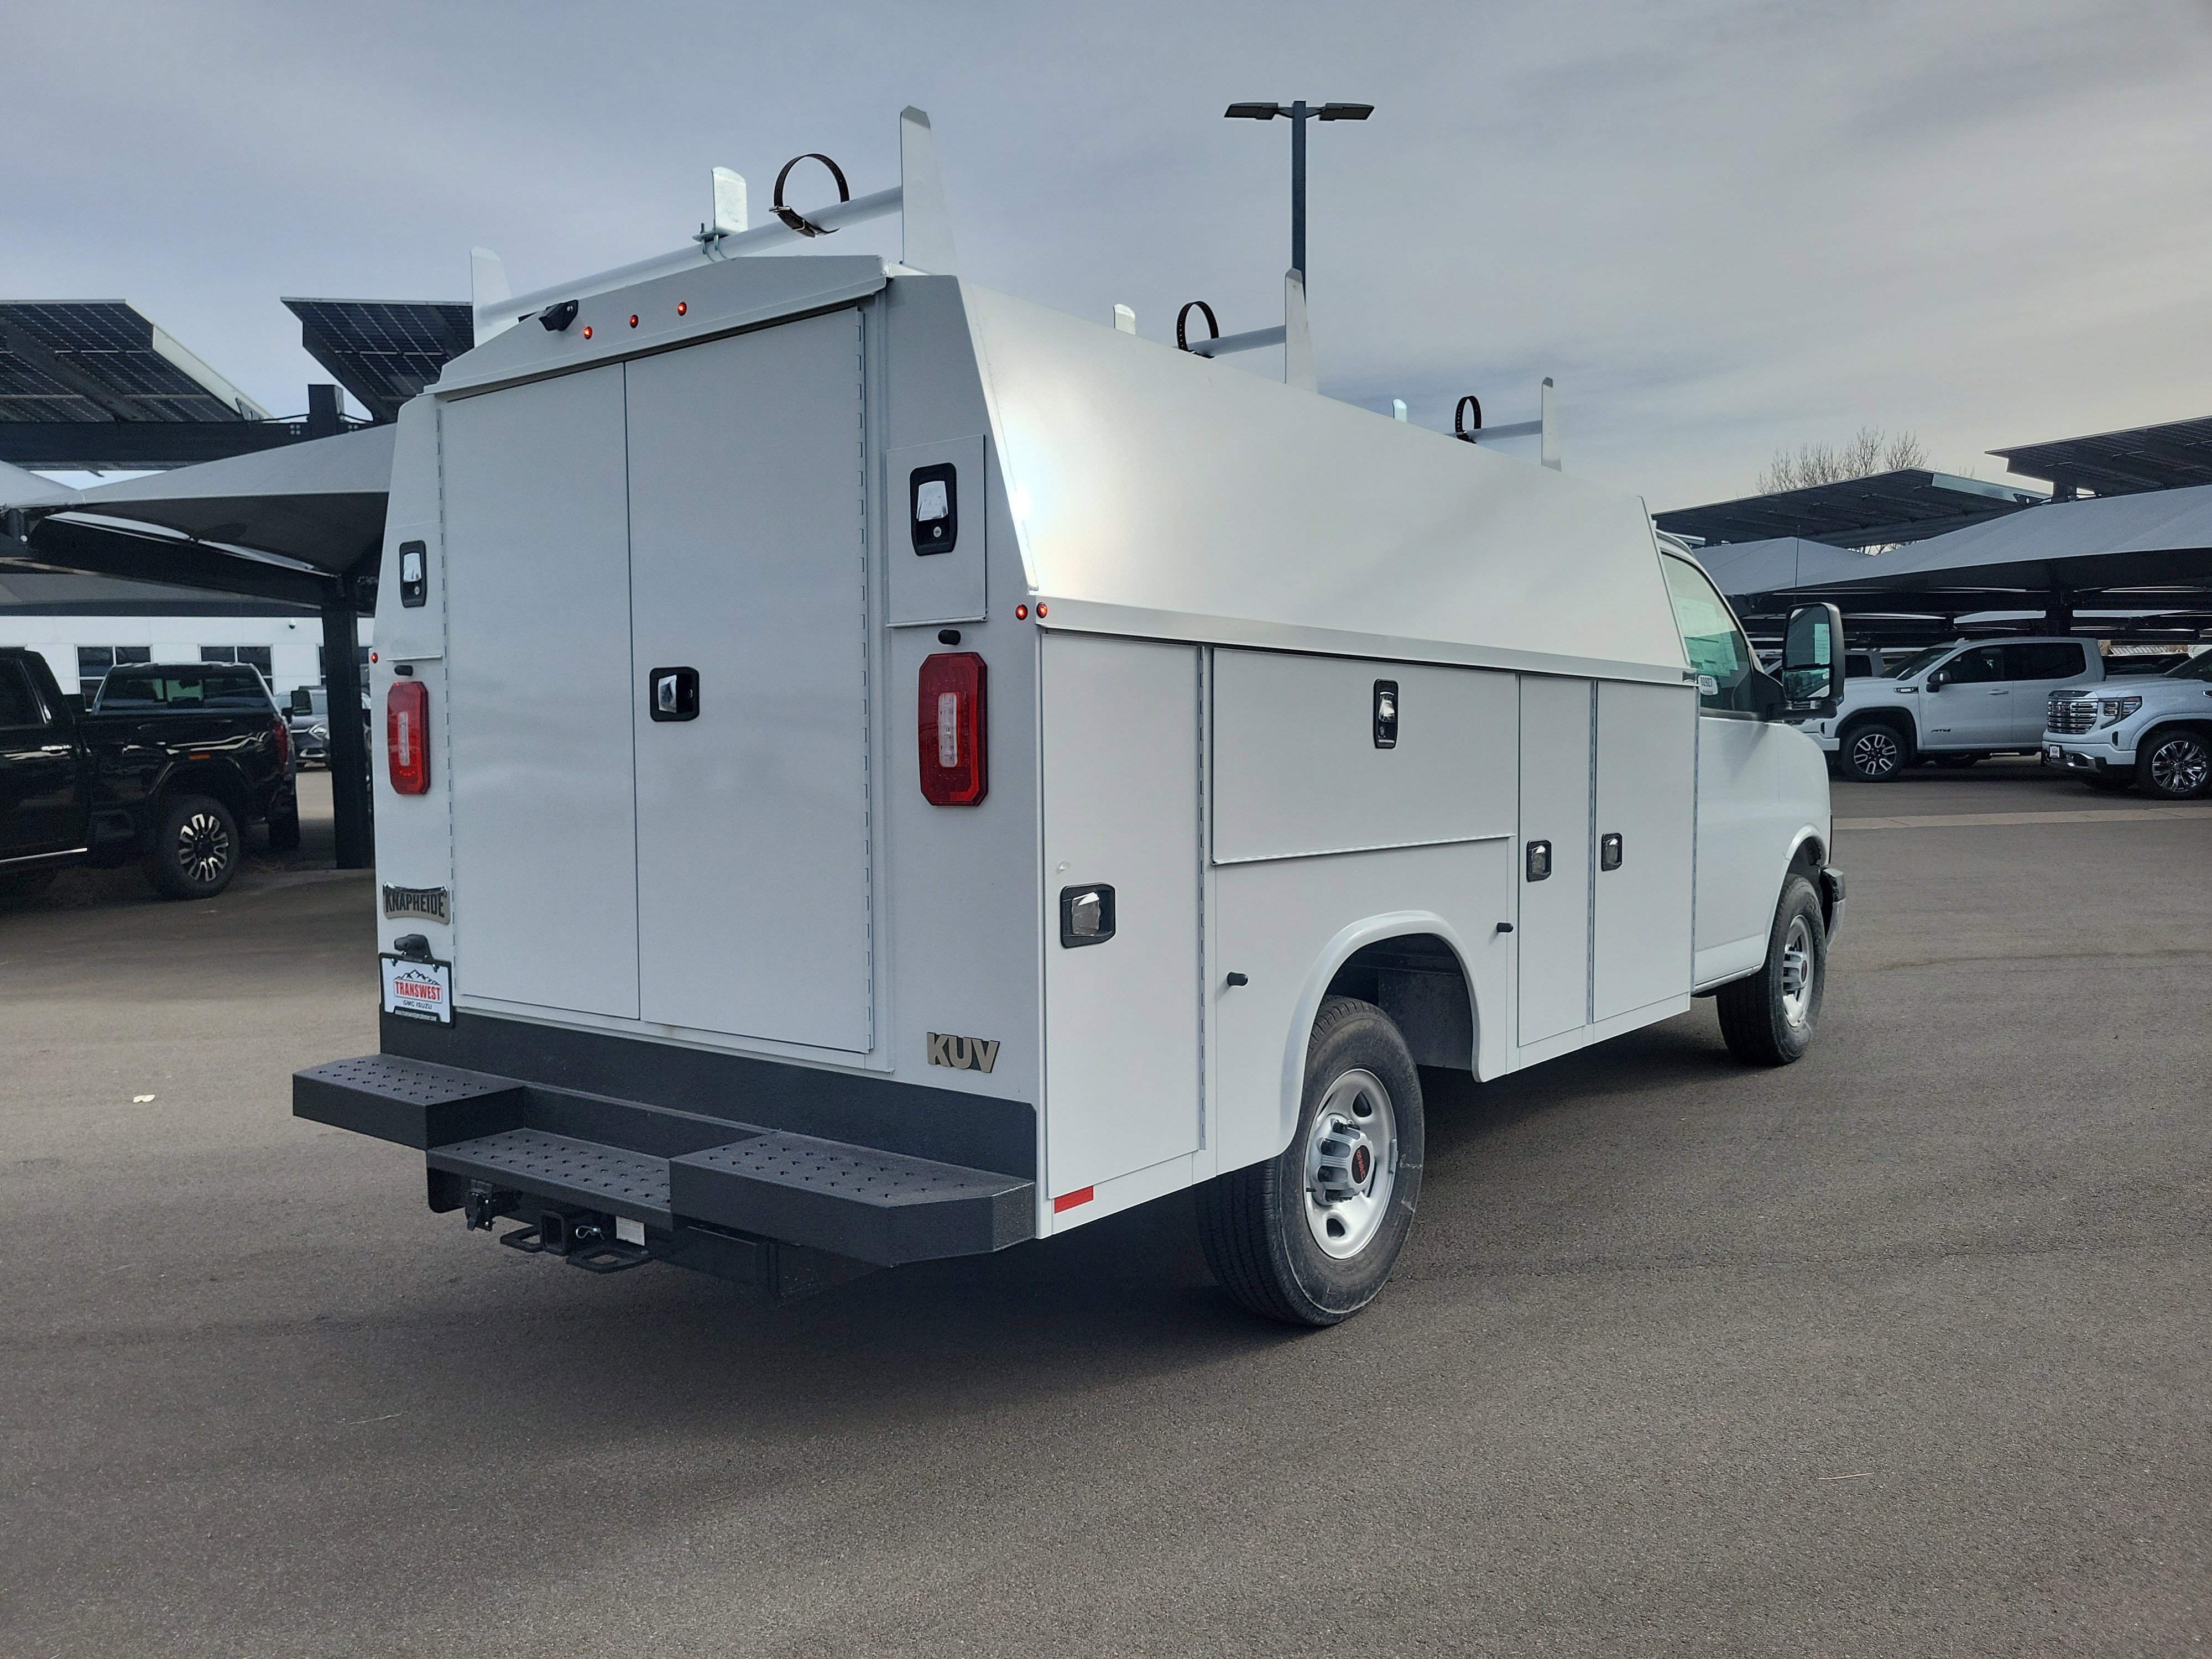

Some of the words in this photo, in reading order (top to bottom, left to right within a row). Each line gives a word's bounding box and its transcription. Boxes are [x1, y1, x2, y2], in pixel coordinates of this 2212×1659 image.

[385, 889, 445, 918] KNAPHEIDE
[395, 982, 441, 1000] TRANSWEST
[927, 1031, 1000, 1073] KUV
